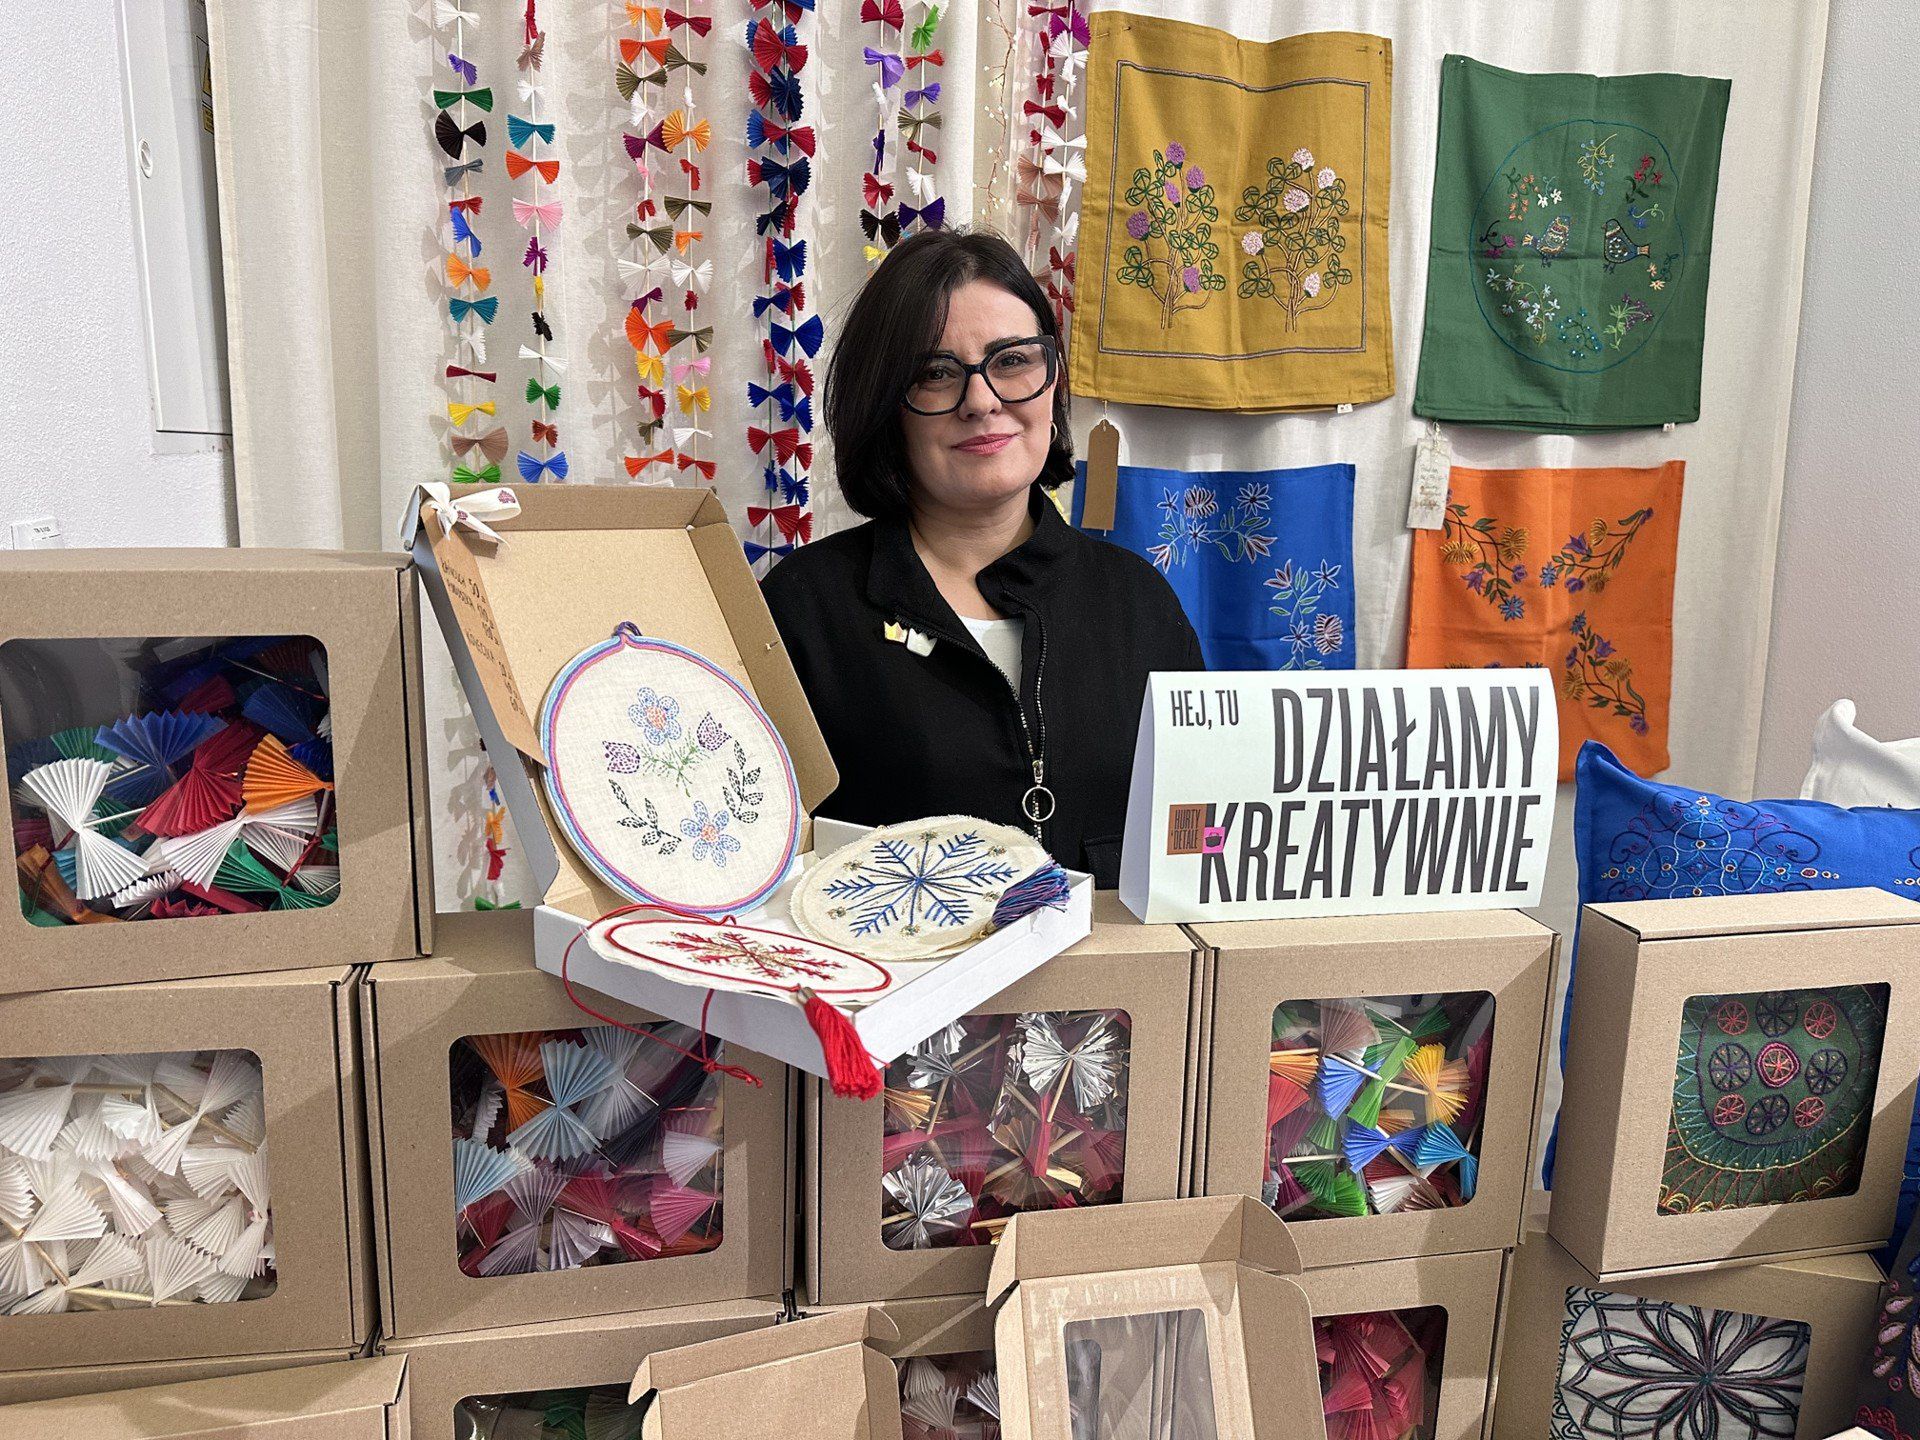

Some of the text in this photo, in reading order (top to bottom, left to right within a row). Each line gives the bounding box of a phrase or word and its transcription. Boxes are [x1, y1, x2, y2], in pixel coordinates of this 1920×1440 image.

[1170, 689, 1240, 730] HEJ, TU
[1271, 685, 1540, 794] DZIAŁAMY
[1173, 829, 1199, 850] DETALE
[1174, 809, 1201, 830] HURTY
[1199, 794, 1541, 904] KREATYWNIE
